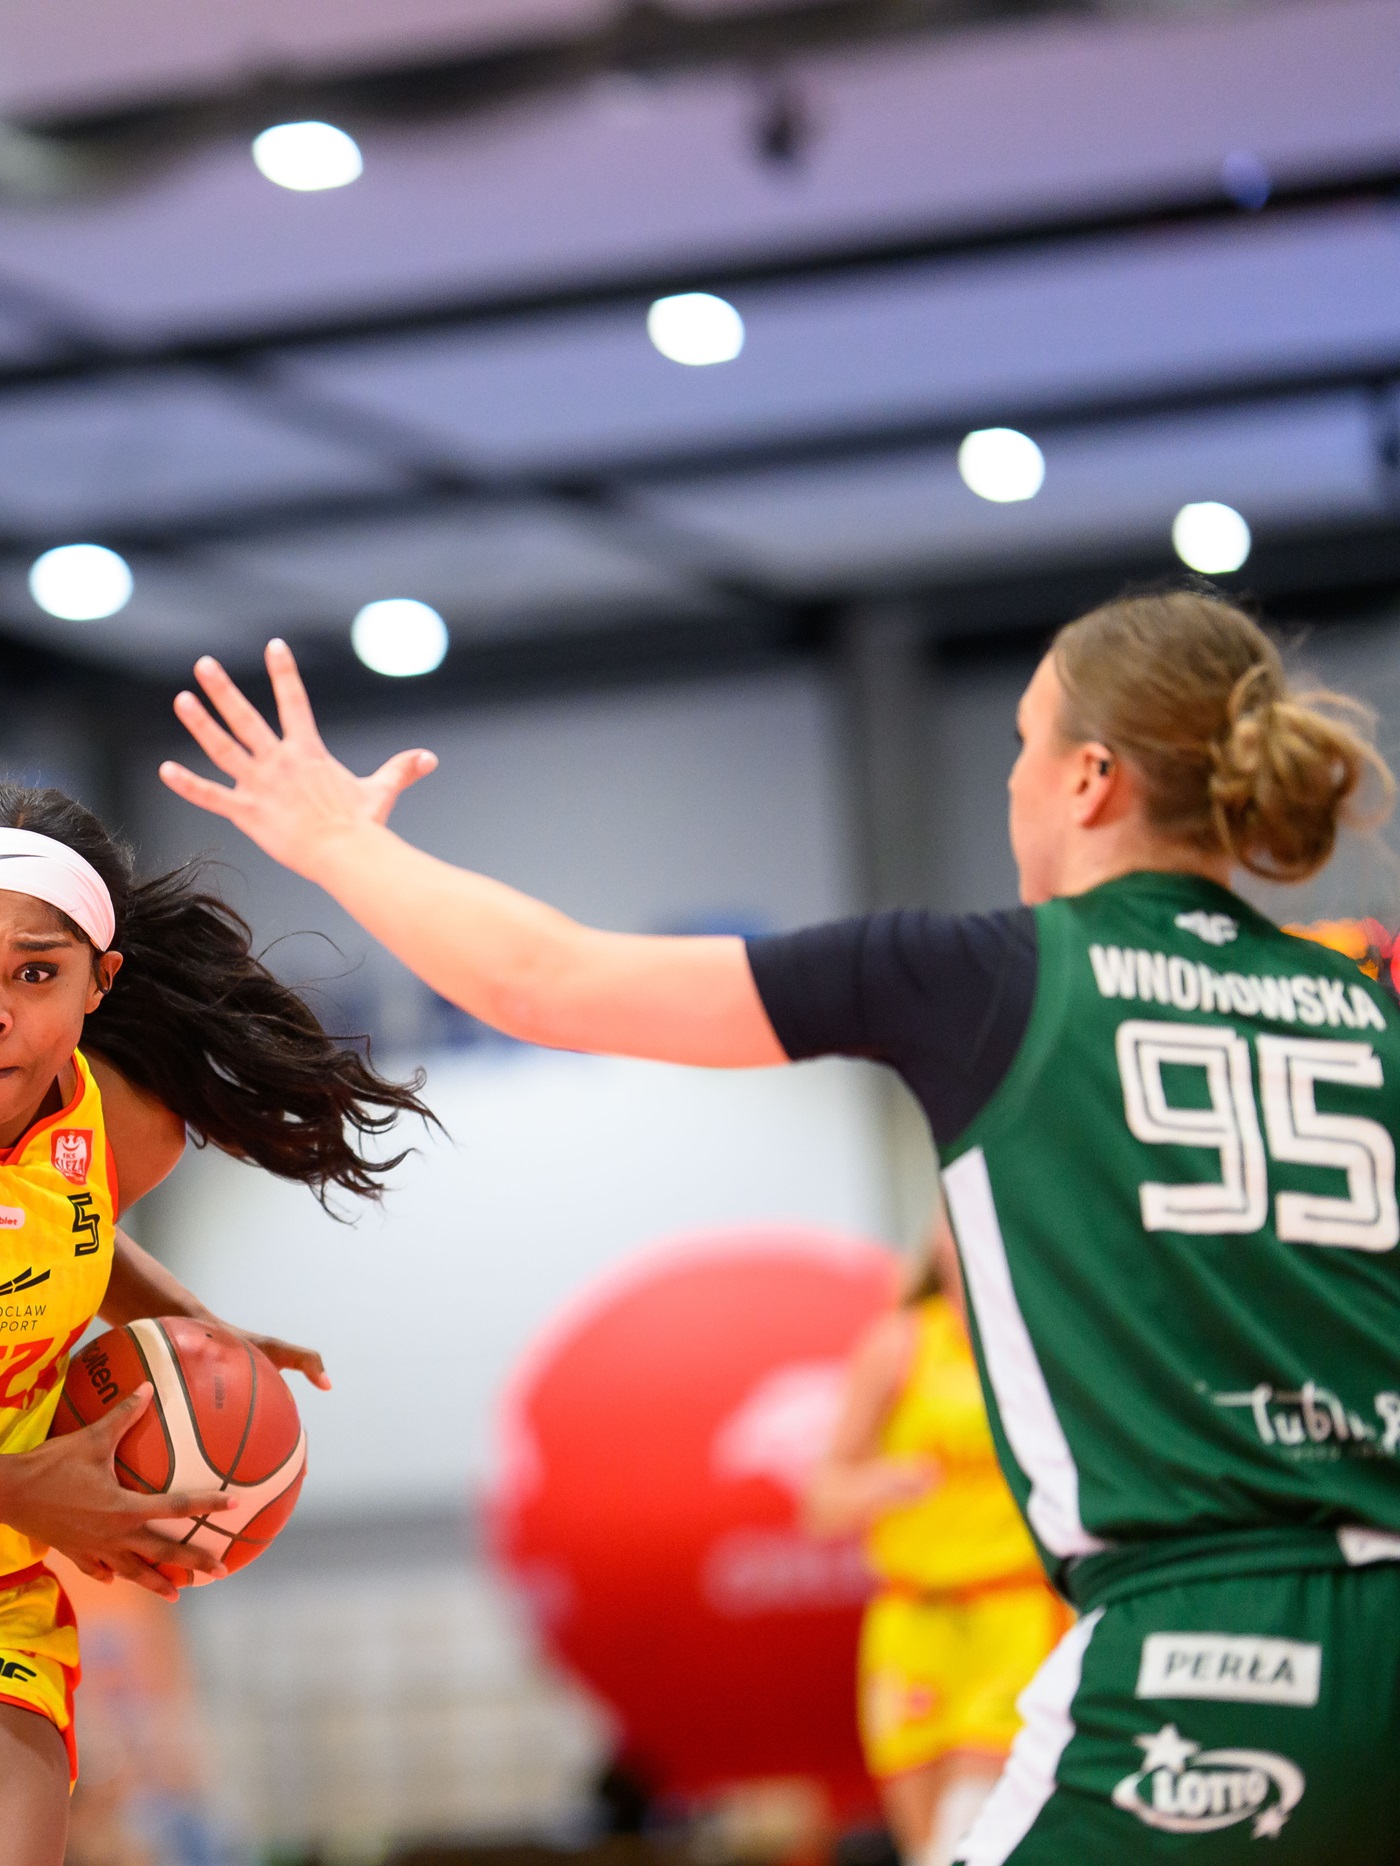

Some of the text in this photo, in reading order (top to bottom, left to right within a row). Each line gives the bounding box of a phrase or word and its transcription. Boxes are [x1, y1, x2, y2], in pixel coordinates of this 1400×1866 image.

[1115, 1020, 1400, 1252] 95
[68, 1192, 101, 1257] 5
[1163, 1650, 1297, 1689] PERŁA
[1152, 1770, 1270, 1820] LOTTO
